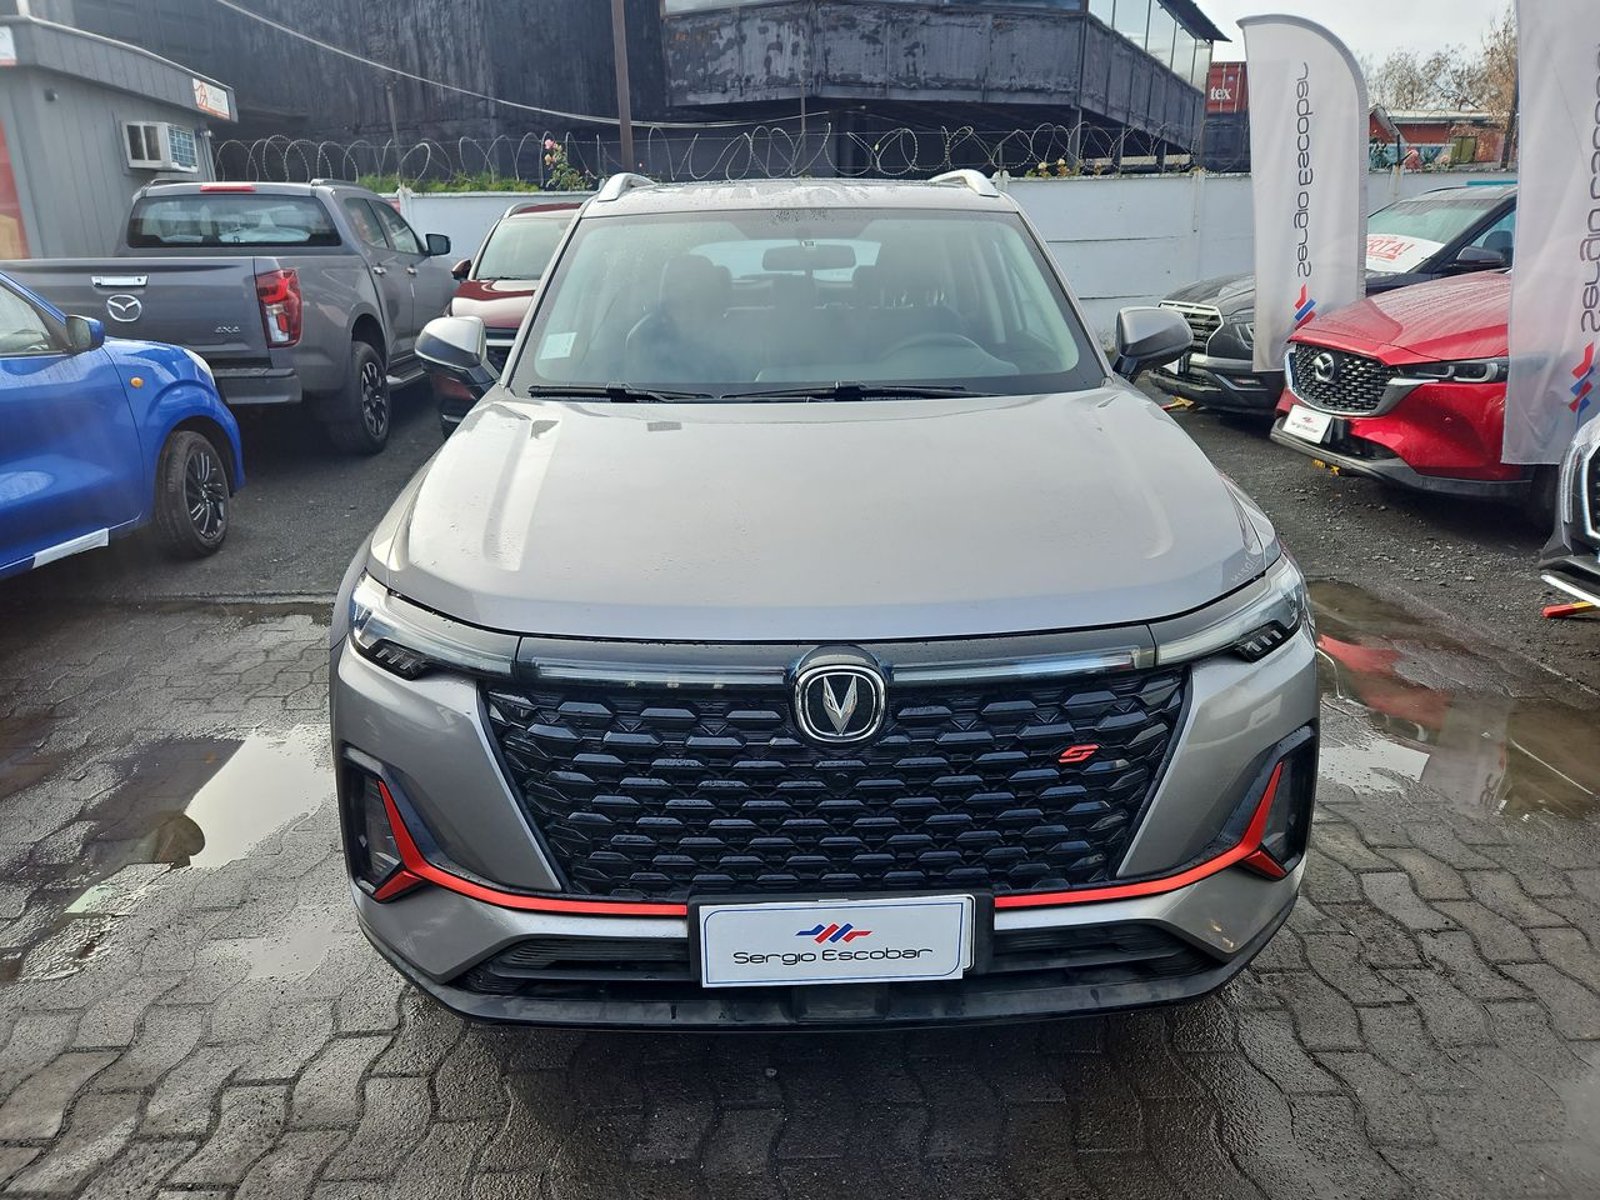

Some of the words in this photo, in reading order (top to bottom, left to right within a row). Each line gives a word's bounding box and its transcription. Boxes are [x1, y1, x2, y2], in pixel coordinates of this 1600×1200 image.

[1210, 86, 1232, 101] tex
[733, 950, 817, 966] Sergio
[821, 947, 933, 962] Escobar
